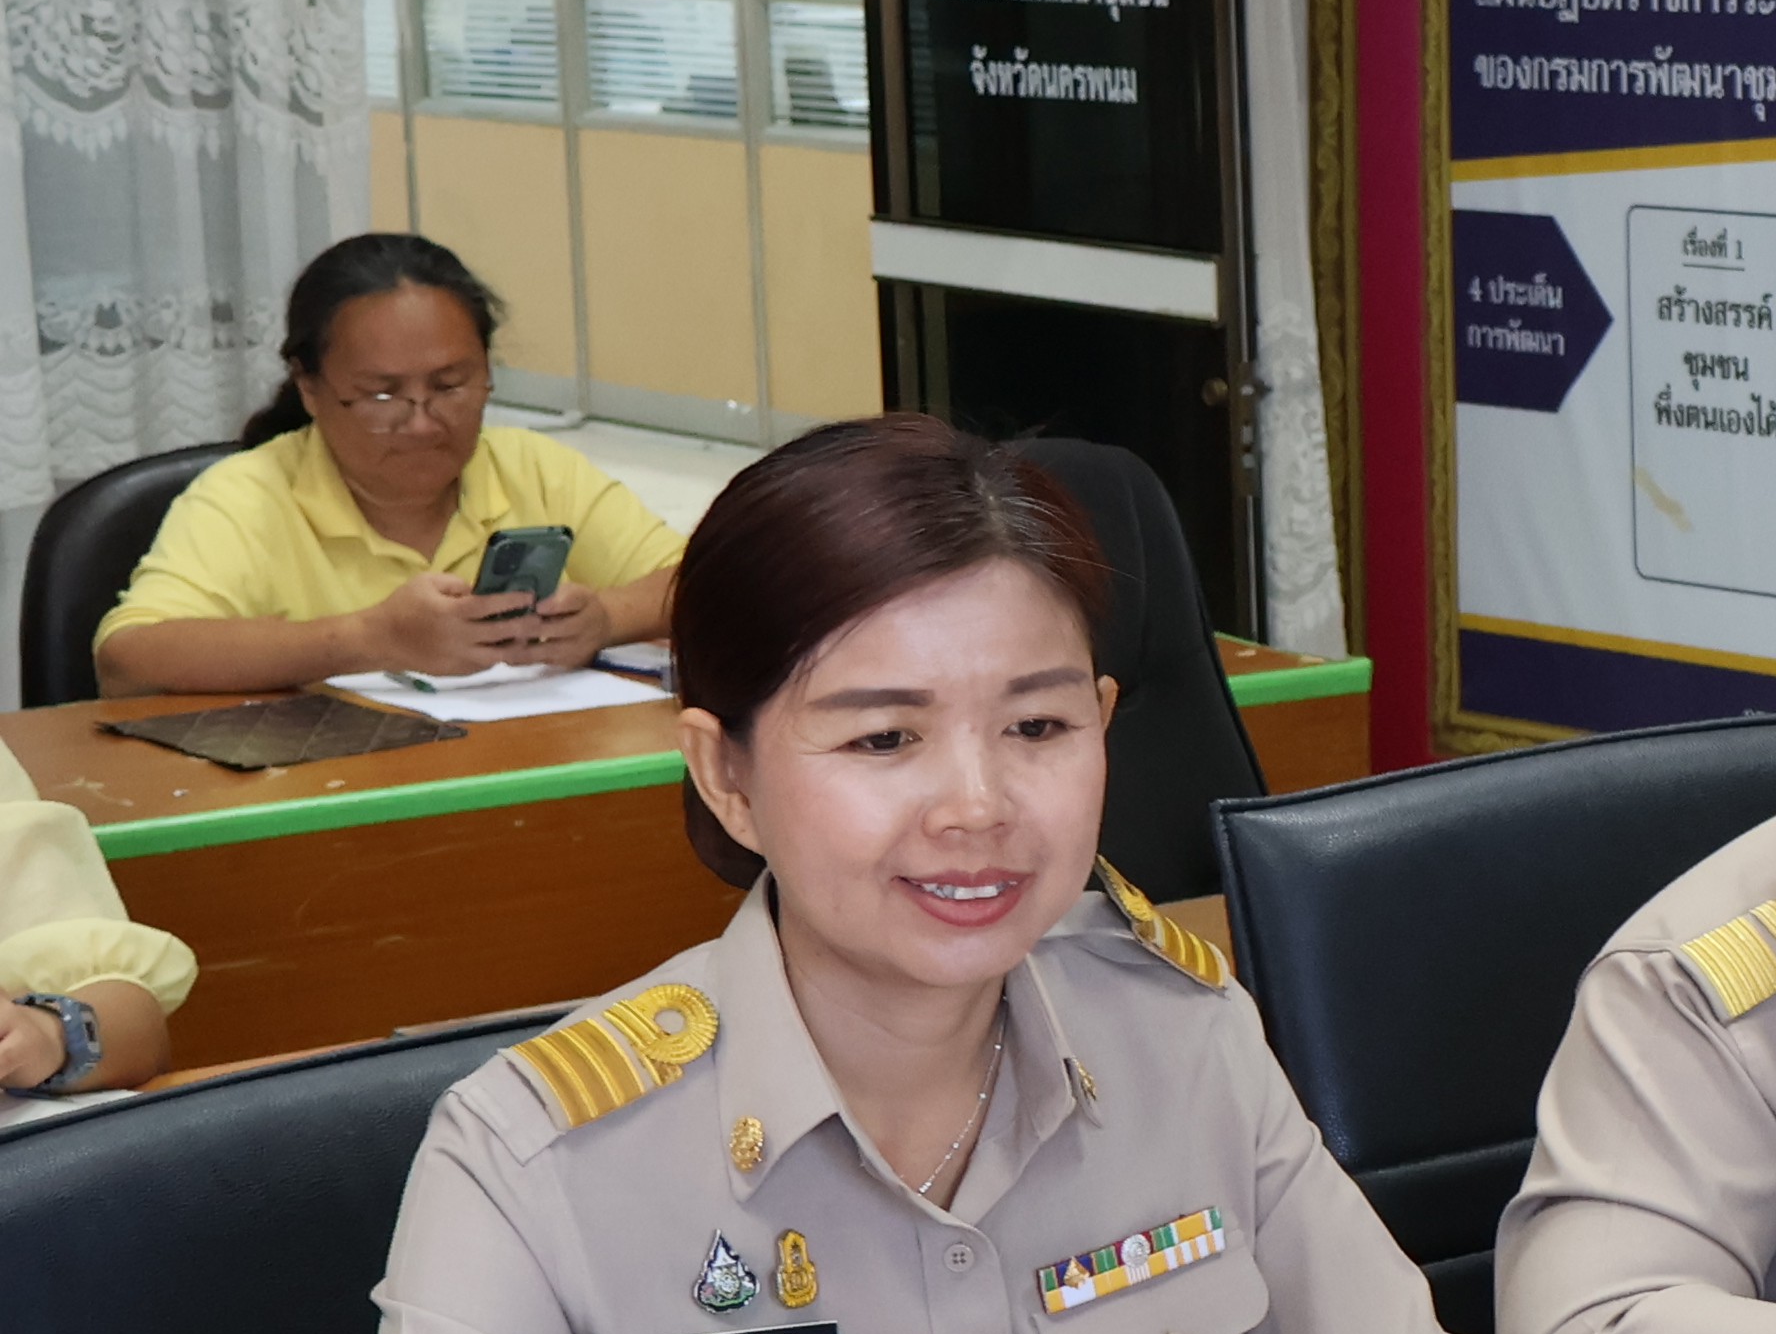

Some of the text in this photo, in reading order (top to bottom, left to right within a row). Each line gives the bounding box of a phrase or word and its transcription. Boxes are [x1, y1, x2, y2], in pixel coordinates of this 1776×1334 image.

[969, 43, 1139, 105] จังหวัดนครพนม
[1682, 229, 1745, 263] เรื่องที่ 1
[1468, 271, 1564, 311] 4 ประเด็น
[1657, 286, 1775, 331] สร้างสรรค์
[1466, 317, 1566, 359] การพัฒนา
[1682, 347, 1751, 393] ชุมชน
